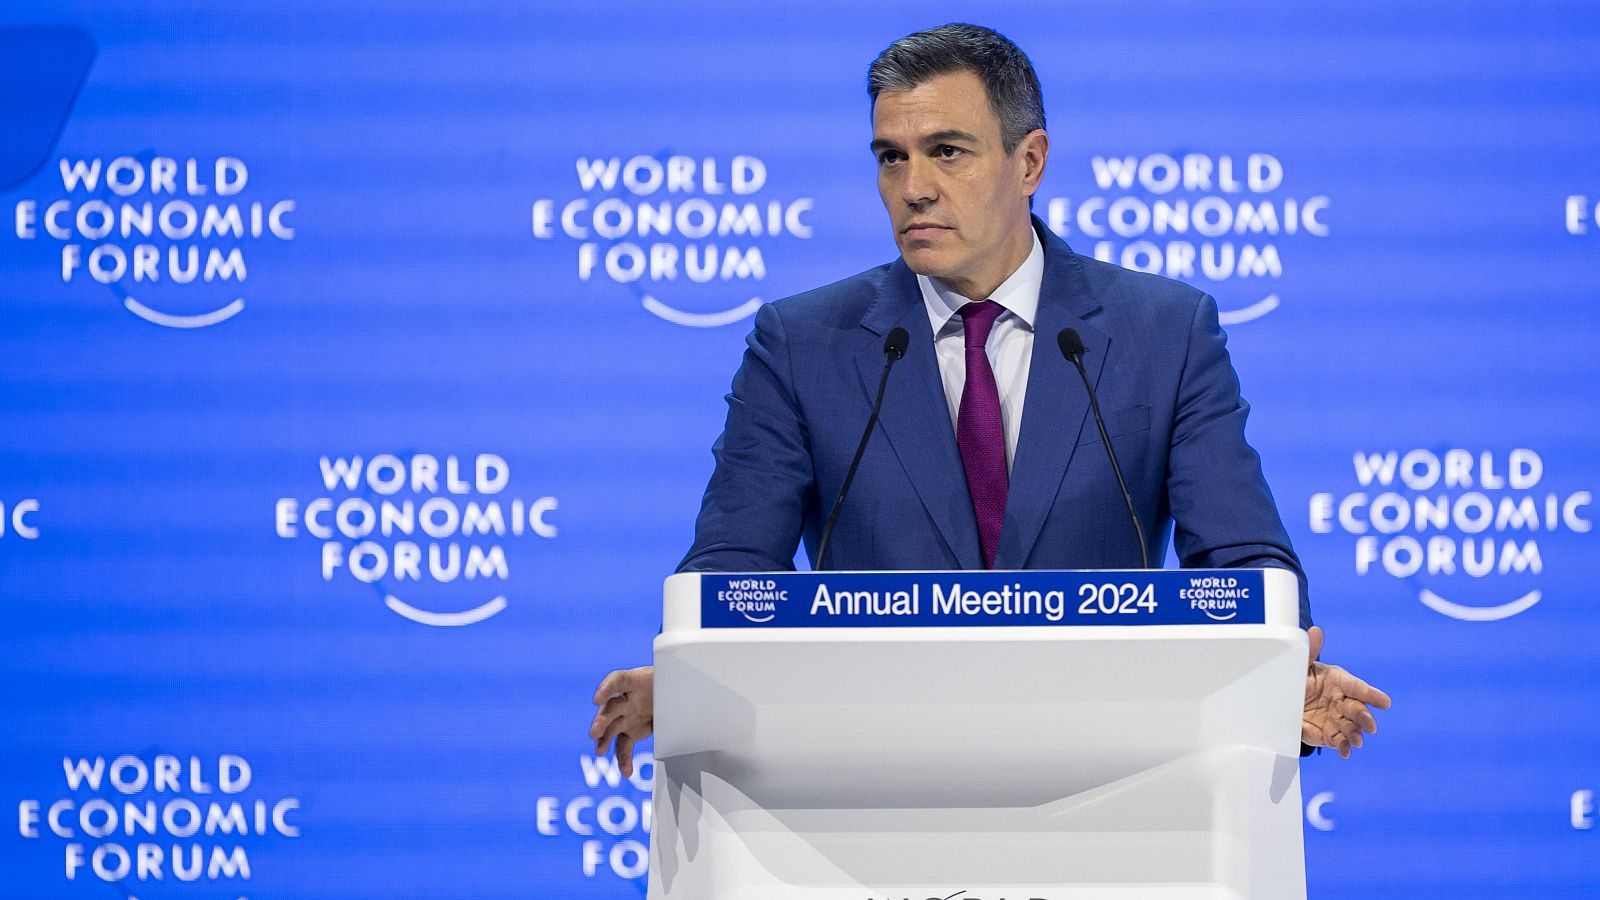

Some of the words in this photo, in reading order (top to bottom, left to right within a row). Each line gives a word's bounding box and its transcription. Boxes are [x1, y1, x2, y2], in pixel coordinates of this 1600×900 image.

[59, 156, 249, 196] WORLD
[575, 154, 767, 195] WORLD
[1091, 153, 1284, 194] WORLD
[15, 199, 296, 240] ECONOMIC
[532, 198, 813, 239] ECONOMIC
[1048, 196, 1330, 237] ECONOMIC
[62, 244, 247, 283] FORUM
[578, 242, 766, 283] FORUM
[319, 453, 510, 495] WORLD
[1353, 448, 1544, 490] WORLD
[275, 496, 558, 538] ECONOMIC
[1309, 491, 1592, 534] ECONOMIC
[322, 541, 509, 583] FORUM
[1355, 535, 1543, 578] FORUM
[718, 590, 788, 602] ECONOMIC
[729, 580, 776, 591] WORLD
[810, 583, 919, 616] Annual
[932, 583, 1065, 622] Meeting
[1078, 582, 1159, 615] 2024
[1179, 587, 1250, 600] ECONOMIC
[1190, 577, 1238, 588] WORLD
[729, 601, 776, 612] FORUM
[1190, 599, 1238, 610] FORUM
[63, 754, 252, 795] WORLD
[18, 797, 300, 838] ECONOMIC
[65, 842, 251, 882] FORUM
